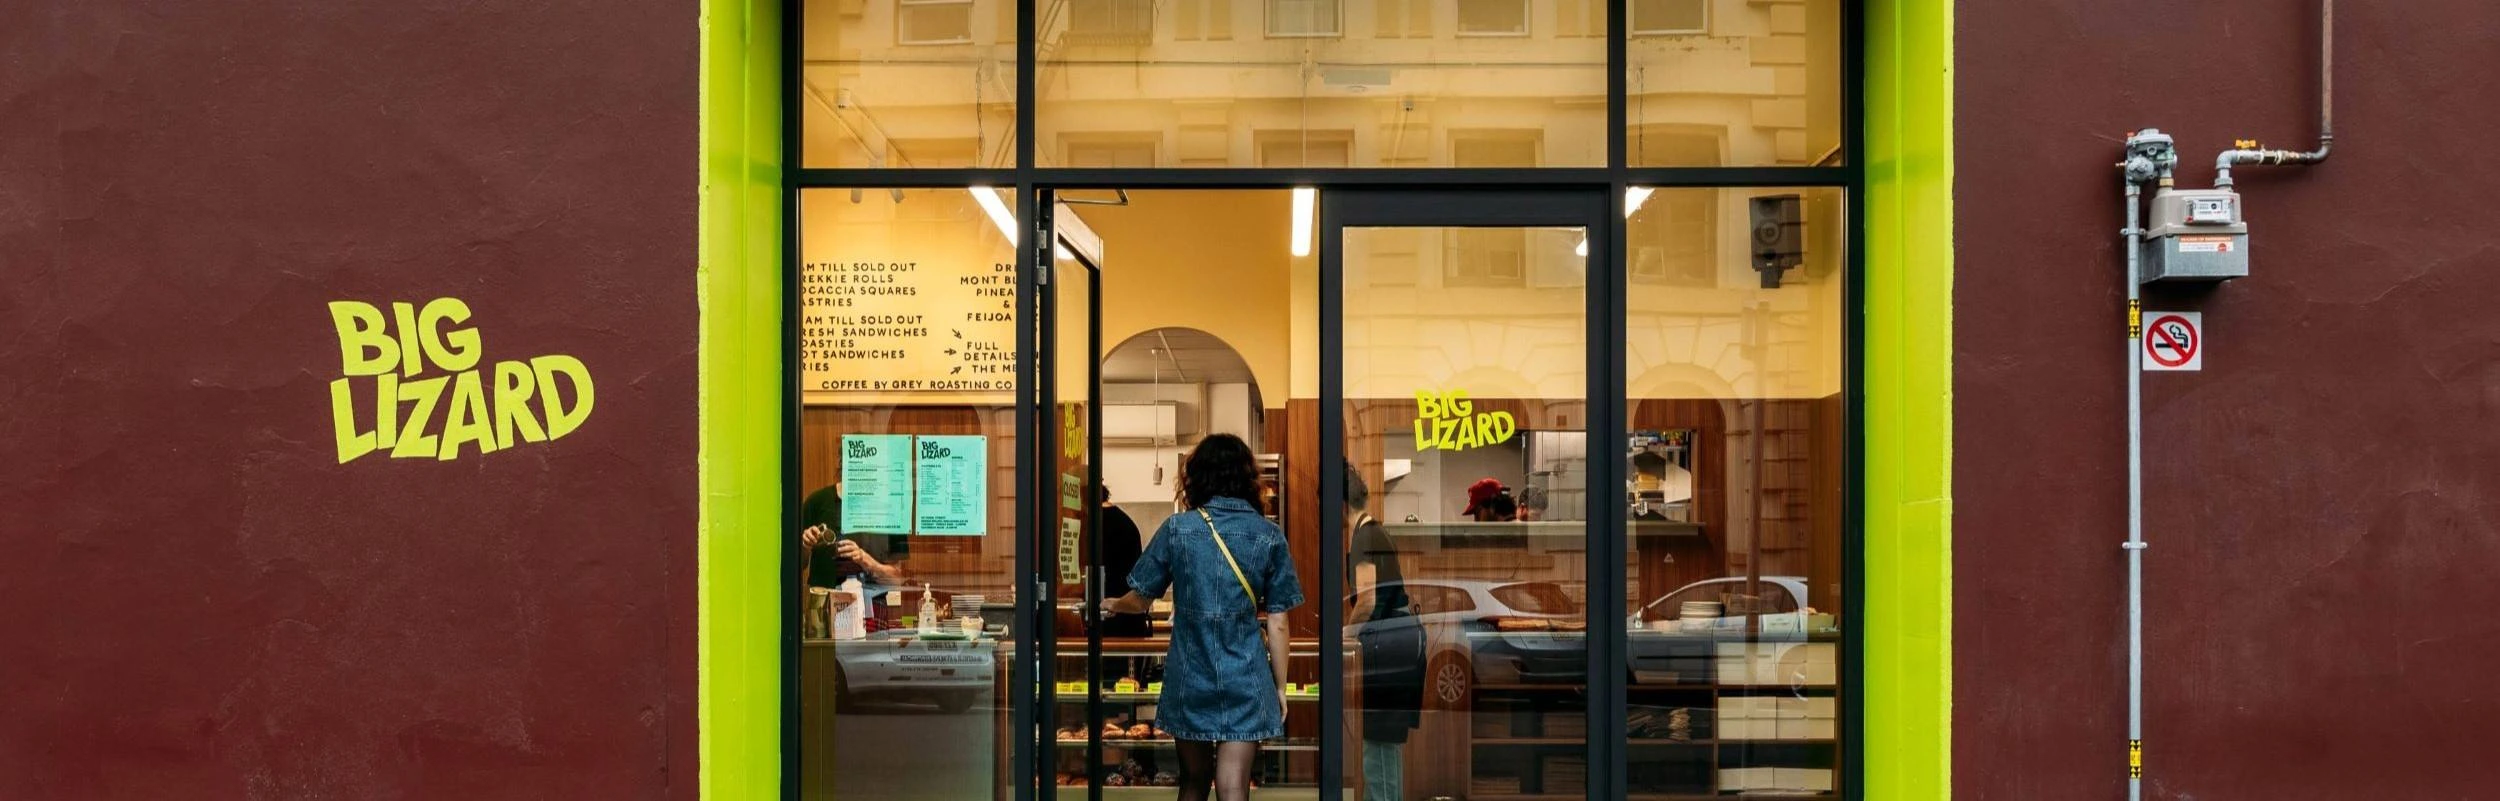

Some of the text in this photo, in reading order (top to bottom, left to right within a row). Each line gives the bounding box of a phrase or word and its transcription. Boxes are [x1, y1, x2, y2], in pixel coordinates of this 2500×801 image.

[803, 263, 917, 272] M TILL SOLD OUT
[853, 274, 894, 283] ROLLS
[960, 276, 998, 285] MONT
[860, 286, 916, 296] SQUARES
[976, 288, 1014, 297] PINEA
[1003, 300, 1010, 309] &
[805, 315, 923, 325] AM TILL SOLD OUT
[967, 312, 1012, 321] FEIJOA
[842, 327, 928, 337] SANDWICHES
[328, 297, 482, 378] BIG
[967, 341, 999, 350] FULL
[823, 349, 905, 359] SANDWICHES
[964, 351, 1016, 361] DETAILS
[972, 364, 996, 373] THE
[821, 380, 1012, 390] COFFEE BY GREY ROASTING CO
[1414, 388, 1473, 419] BIG
[330, 354, 595, 464] LIZARD
[1414, 411, 1516, 451] LIZARD
[848, 440, 866, 450] BIG
[921, 441, 939, 451] BIG
[848, 447, 878, 459] LIZARD
[921, 447, 951, 459] LIZARD
